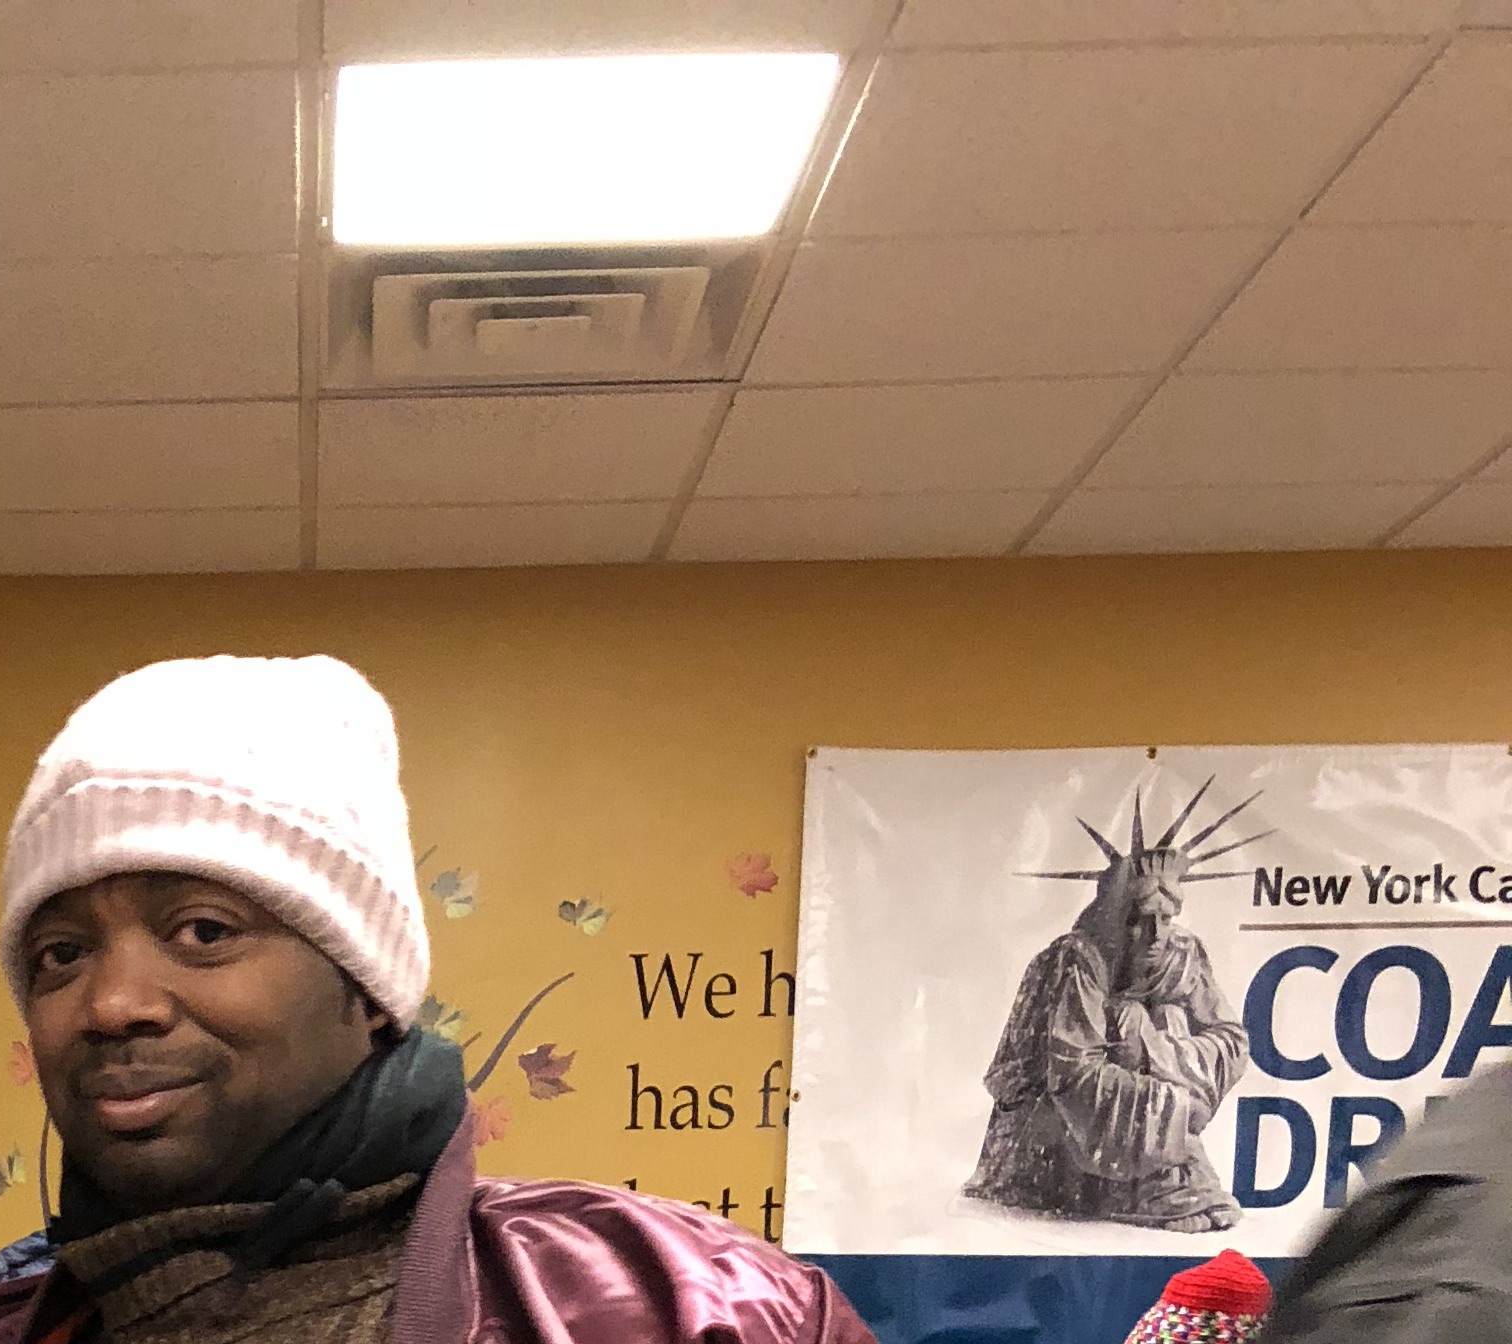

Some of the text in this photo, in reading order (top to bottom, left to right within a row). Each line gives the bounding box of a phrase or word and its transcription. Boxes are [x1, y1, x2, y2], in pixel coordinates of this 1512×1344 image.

[1252, 866, 1352, 907] New
[1361, 863, 1458, 906] York
[629, 952, 737, 1019] We
[1242, 944, 1512, 1081] COA
[624, 1062, 735, 1130] has
